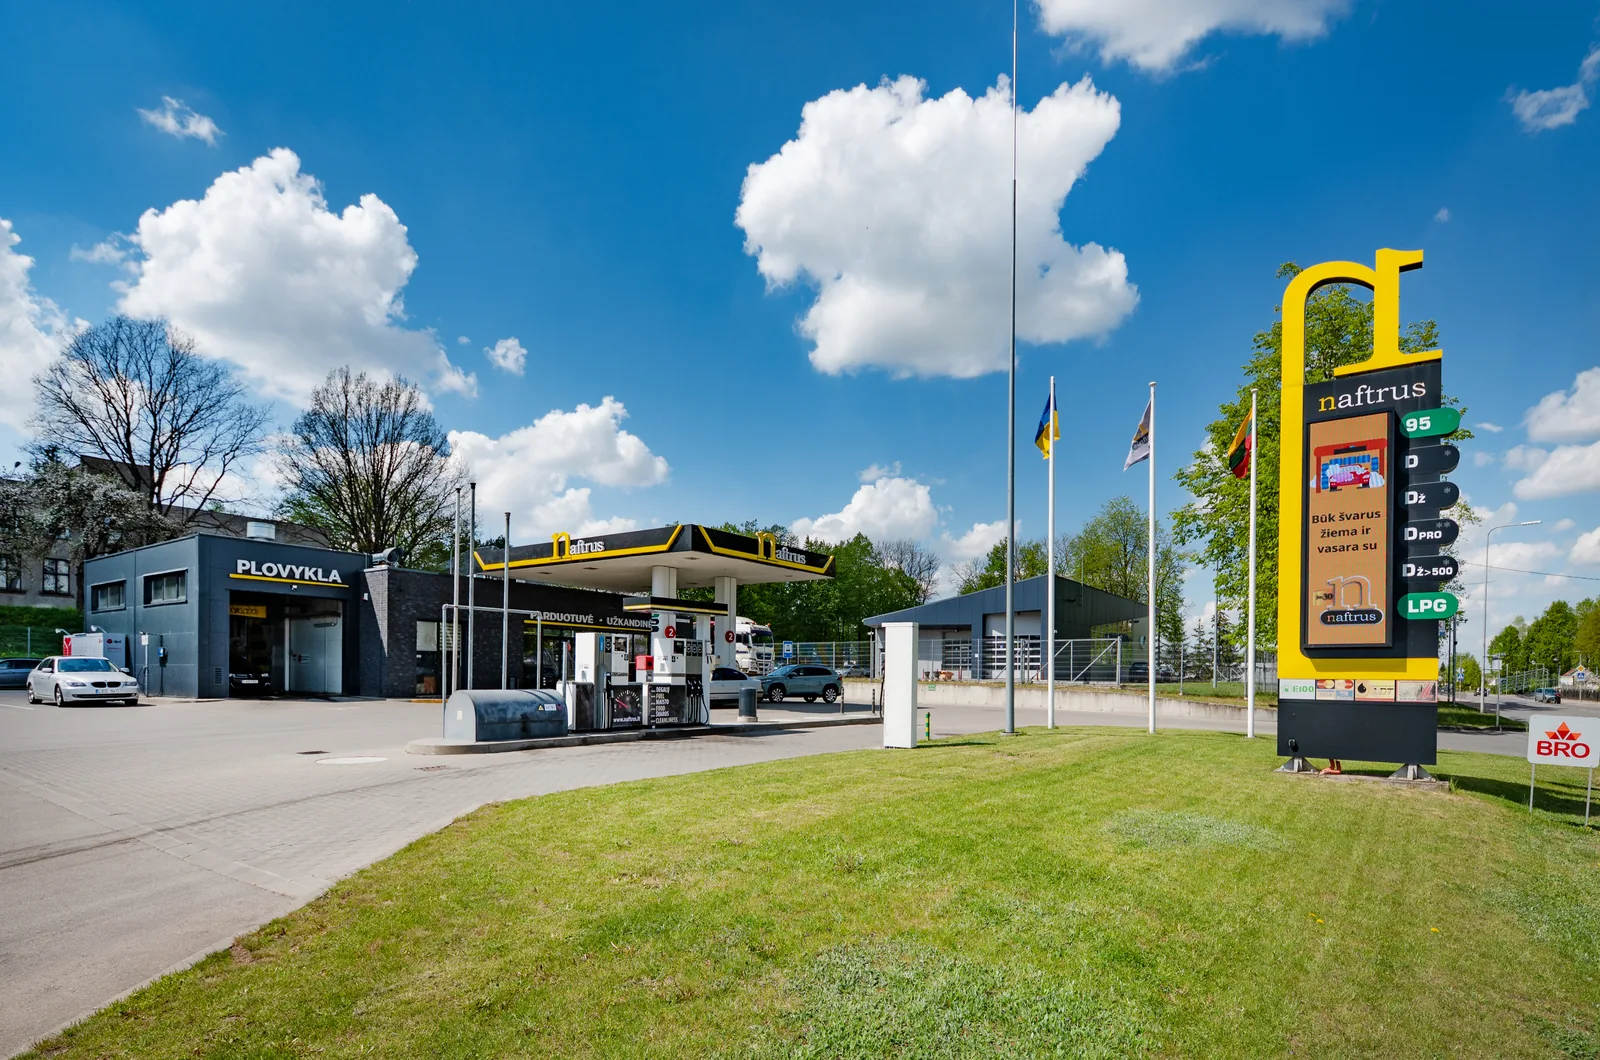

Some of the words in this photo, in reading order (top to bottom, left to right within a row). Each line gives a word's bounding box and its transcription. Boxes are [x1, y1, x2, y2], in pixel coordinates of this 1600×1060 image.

[1318, 381, 1427, 412] naftrus
[1405, 416, 1431, 432] 95
[1404, 454, 1419, 469] D
[1312, 513, 1336, 524] Būk
[1338, 510, 1381, 522] švarus
[1320, 527, 1358, 539] žiema
[1361, 525, 1372, 535] ir
[551, 531, 606, 559] naftrus
[756, 531, 807, 565] naftrus
[1317, 543, 1359, 554] vasara
[1362, 542, 1377, 551] su
[236, 559, 343, 584] PLOVYKLA
[1407, 599, 1447, 614] LPG
[1327, 612, 1377, 623] naftrus
[668, 628, 675, 637] 2
[728, 633, 734, 641] 2
[1536, 740, 1591, 759] BRO
